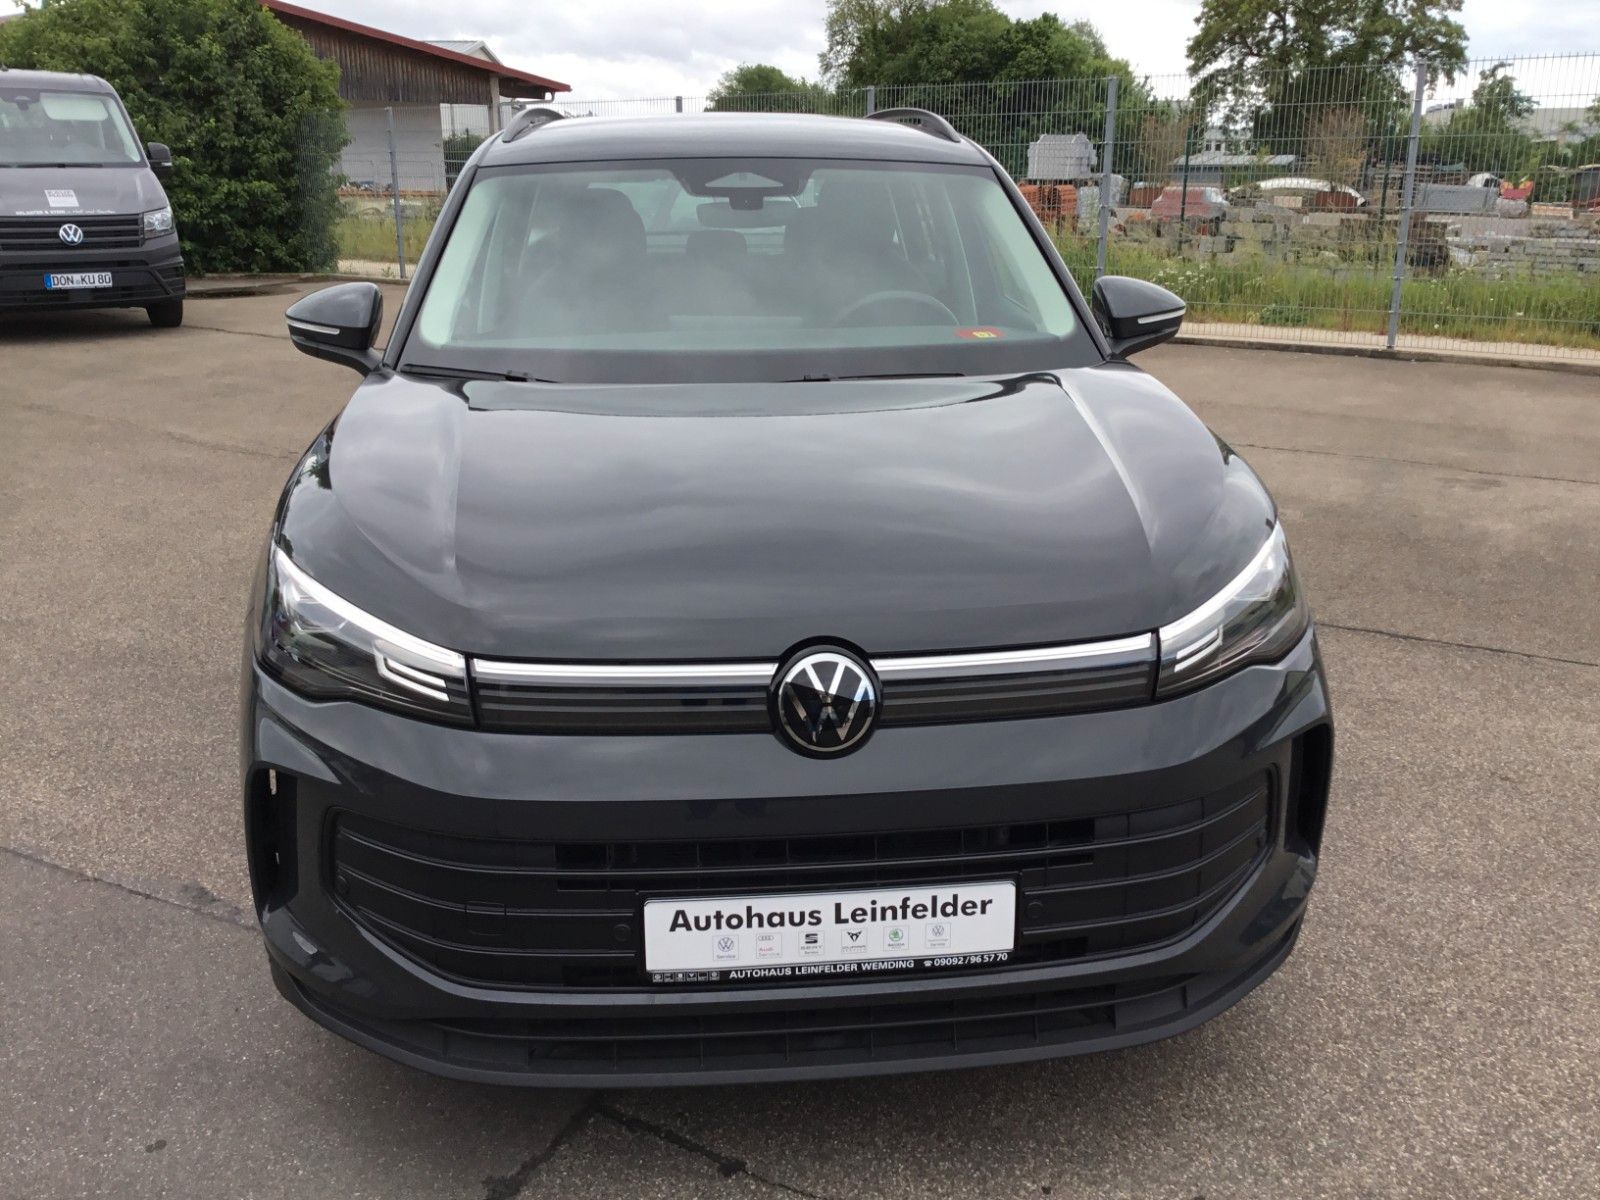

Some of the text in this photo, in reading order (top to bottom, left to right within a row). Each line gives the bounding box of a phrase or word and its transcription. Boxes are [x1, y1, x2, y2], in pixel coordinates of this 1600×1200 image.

[52, 273, 111, 286] DON KU 80
[779, 652, 876, 752] VW
[669, 893, 993, 932] Autohaus Leinfelder
[729, 967, 792, 979] AUTOHAUS
[795, 963, 858, 975] LEINFELDER
[861, 960, 915, 971] WEMDING
